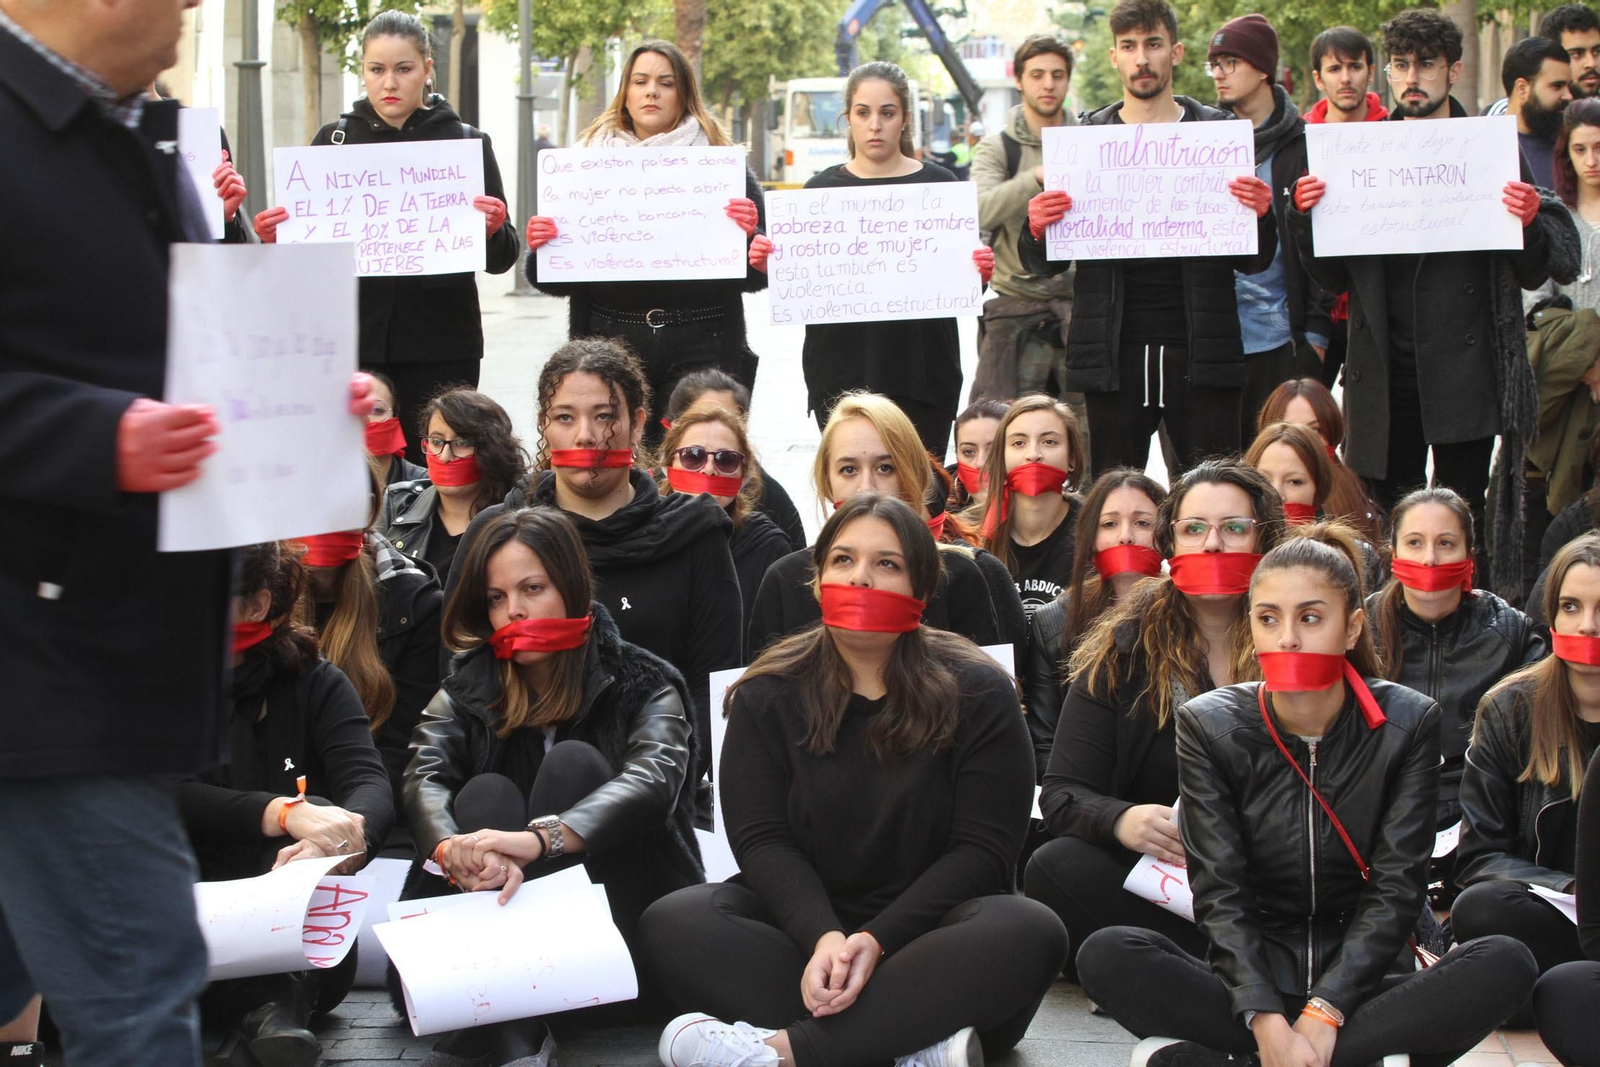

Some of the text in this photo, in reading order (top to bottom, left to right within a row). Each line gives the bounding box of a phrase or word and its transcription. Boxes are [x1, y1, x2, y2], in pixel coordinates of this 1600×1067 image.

[1051, 123, 1250, 168] La malnutrición
[286, 160, 466, 191] A NIVEL MUNDIAL
[542, 153, 739, 175] Que existan países donde
[1351, 162, 1467, 188] ME MATARON
[543, 180, 732, 205] la mujer no pueda abrir
[1086, 169, 1102, 194] la
[1117, 169, 1165, 201] mujer
[1173, 168, 1231, 195] contrib
[295, 191, 469, 218] EL 1% DE LA TIERRA
[771, 188, 943, 217] En el mundo la
[1146, 196, 1161, 214] de
[1171, 197, 1189, 212] las
[1196, 195, 1228, 215] tasas
[332, 221, 351, 239] EL
[361, 221, 390, 241] 10%
[396, 218, 419, 235] DE
[428, 216, 450, 234] LA
[553, 214, 570, 226] na
[771, 213, 976, 239] pobreza tiene nombre
[1049, 213, 1134, 240] mortalidad
[357, 235, 474, 257] PERTENECE A LAS
[773, 237, 938, 261] y rostro de mujer,
[1054, 230, 1253, 260] es violencia estructural
[549, 255, 575, 270] Es
[584, 252, 645, 271] violencia
[775, 257, 918, 282] esto también es
[772, 305, 792, 323] Es
[801, 300, 881, 321] violencia
[10, 1044, 33, 1057] NIKE
